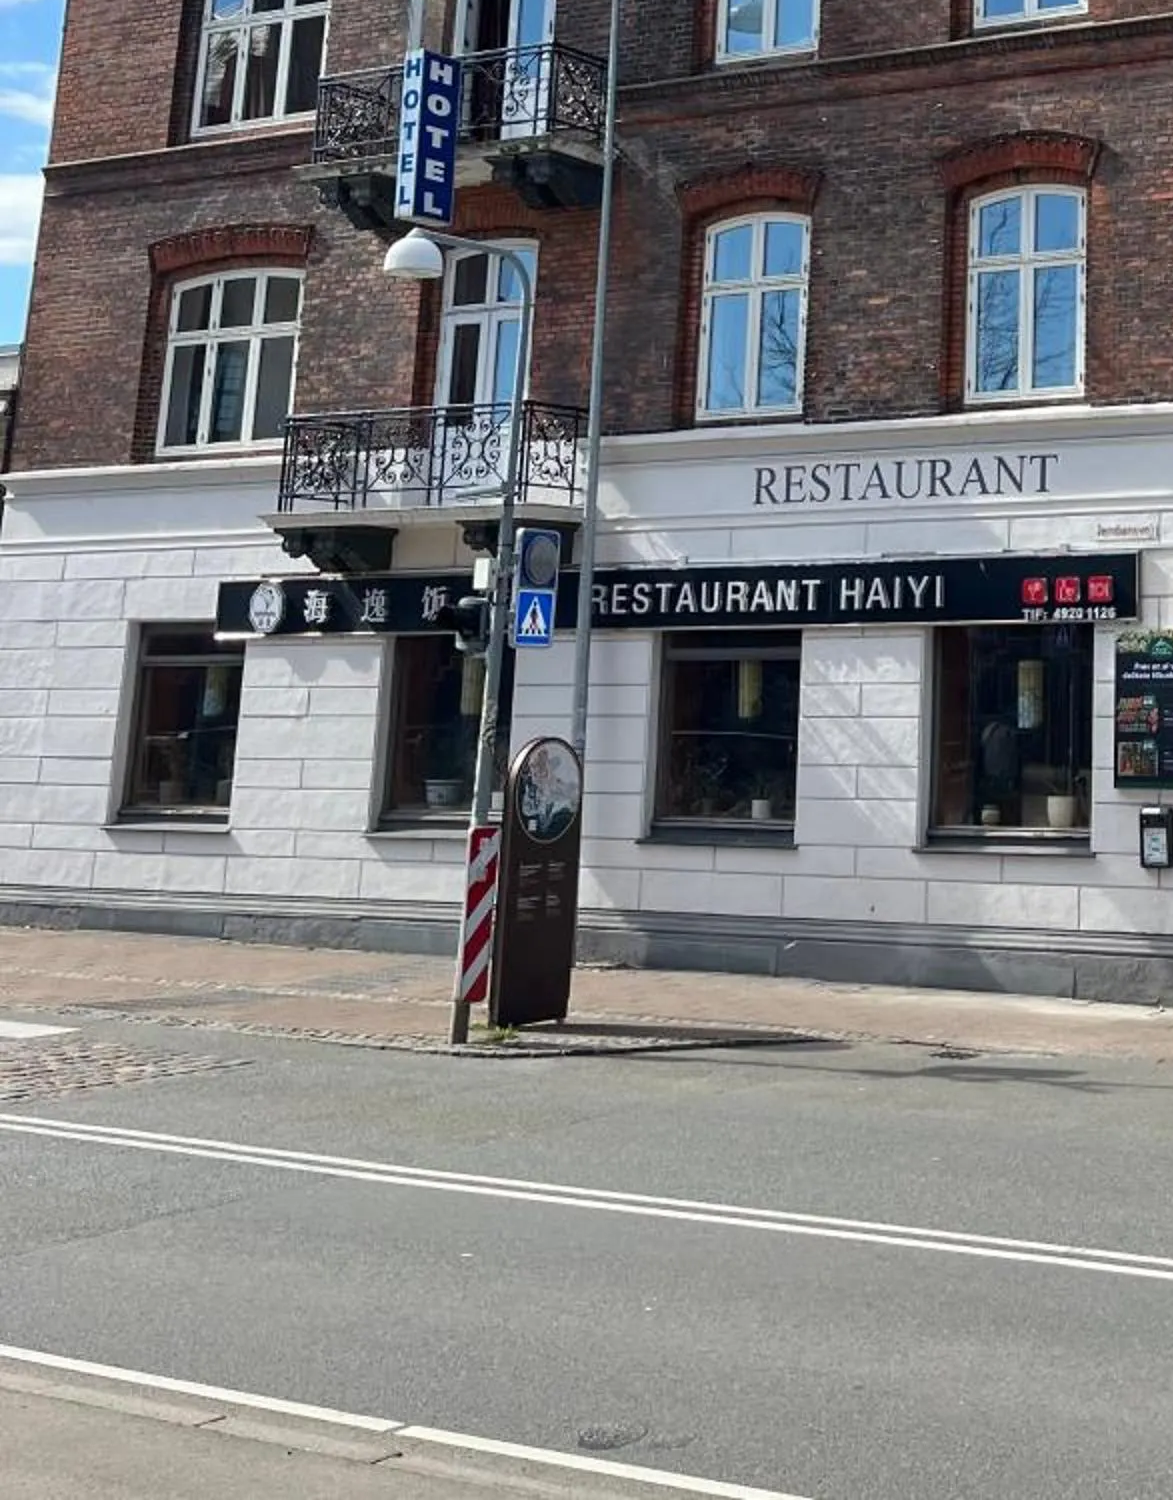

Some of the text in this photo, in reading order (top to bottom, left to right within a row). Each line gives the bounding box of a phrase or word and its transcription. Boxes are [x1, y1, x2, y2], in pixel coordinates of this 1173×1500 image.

[400, 57, 422, 206] HOTEL
[422, 58, 454, 217] HOTEL
[754, 453, 1058, 505] RESTAURANT
[592, 574, 945, 614] RESTAURANT HAIYI
